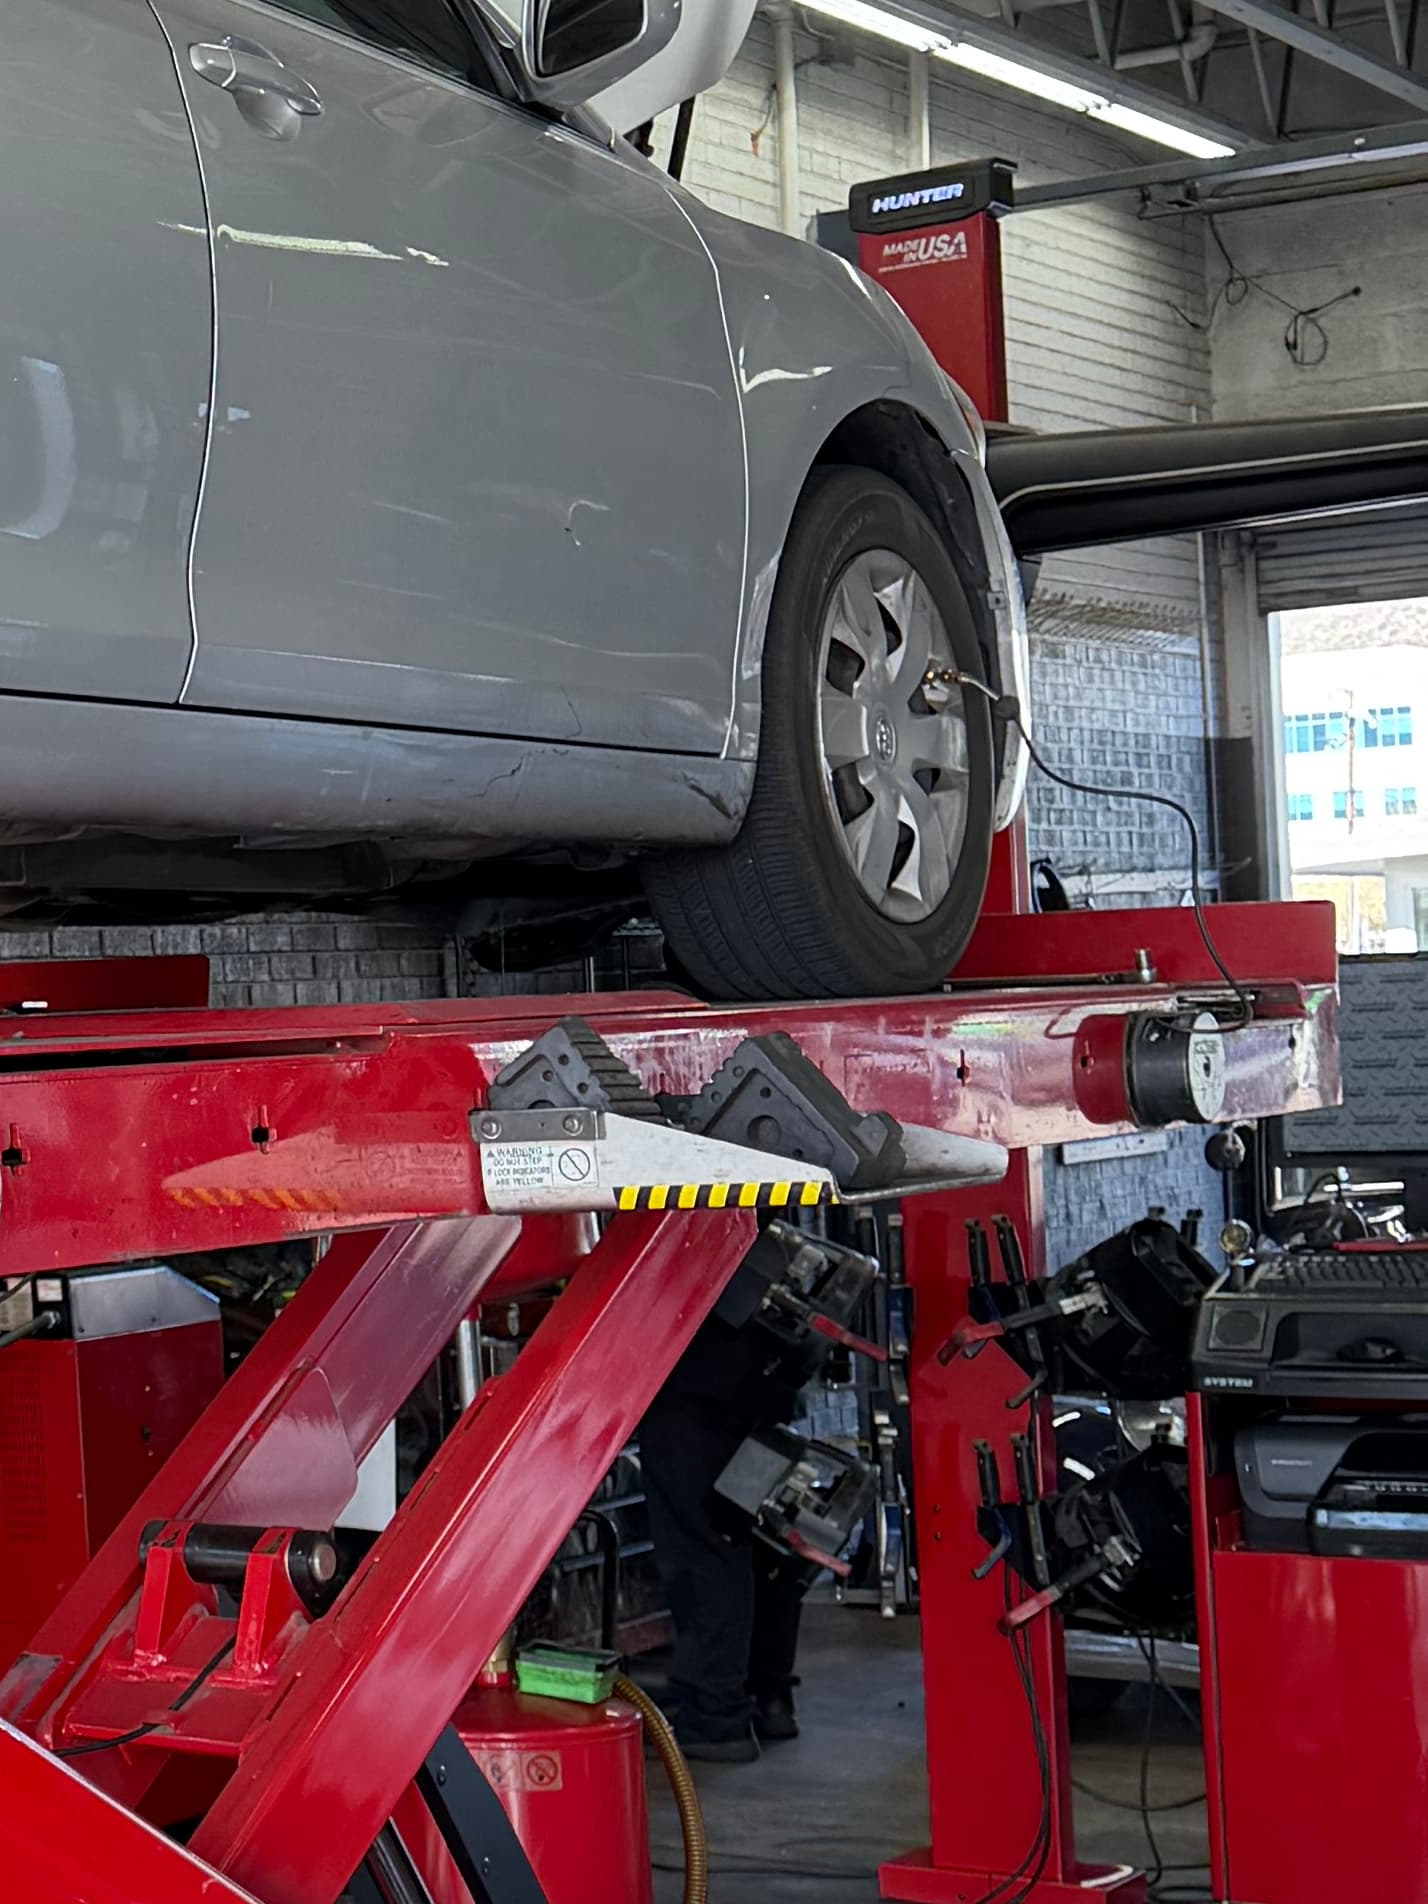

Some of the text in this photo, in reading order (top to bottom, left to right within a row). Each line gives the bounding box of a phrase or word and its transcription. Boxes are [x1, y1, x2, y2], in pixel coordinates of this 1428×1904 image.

[872, 183, 964, 213] HUNTER
[883, 239, 920, 256] MADE
[903, 252, 917, 264] IN
[918, 232, 967, 261] USA
[497, 1146, 543, 1158] WARNING
[494, 1157, 542, 1167] DO NOT STEP
[513, 1177, 544, 1186] YELLOW
